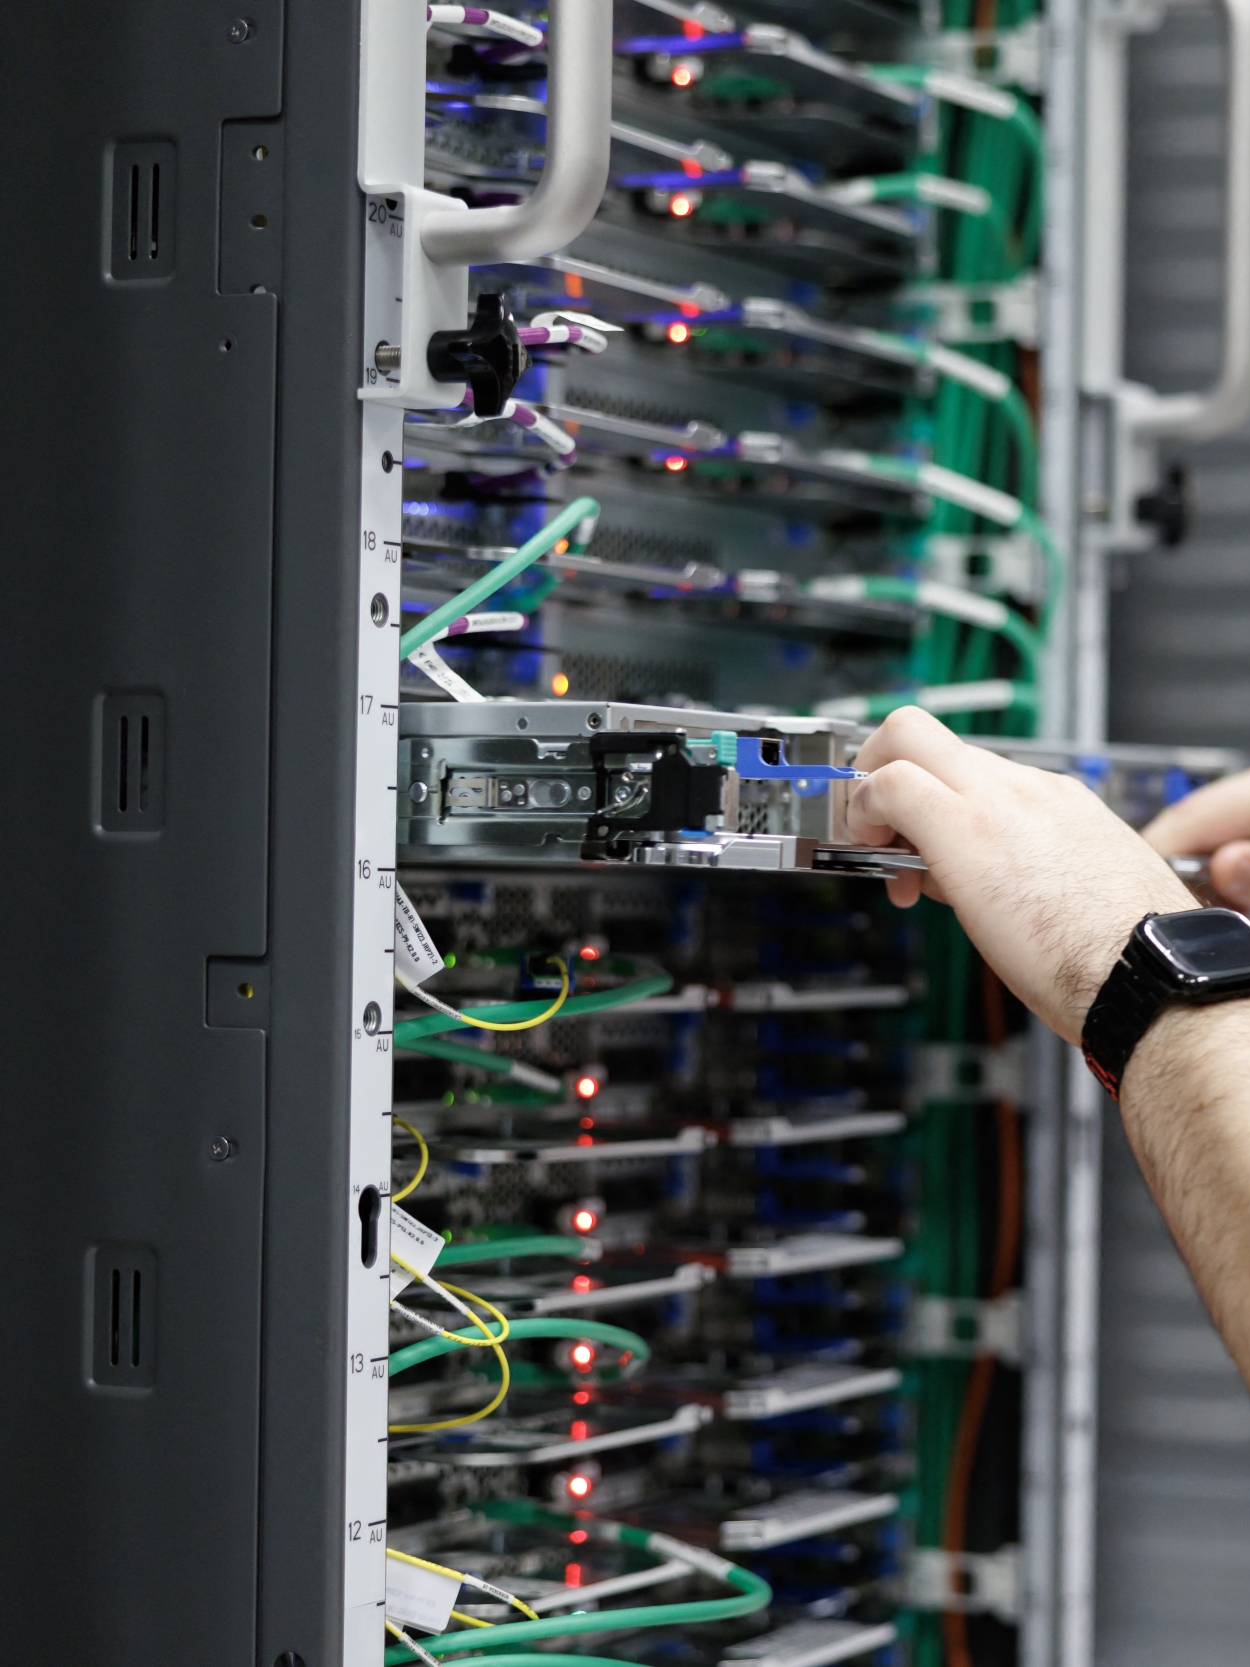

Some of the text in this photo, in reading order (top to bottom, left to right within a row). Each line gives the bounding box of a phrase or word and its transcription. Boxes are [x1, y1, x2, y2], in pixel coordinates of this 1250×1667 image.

[368, 202, 387, 224] 20
[390, 223, 403, 238] AU
[366, 367, 378, 386] 19
[363, 530, 376, 551] 18
[385, 549, 398, 563] AU
[360, 694, 374, 715] 17
[381, 713, 395, 727] AU
[358, 859, 371, 880] 16
[379, 876, 392, 890] AU
[354, 1028, 362, 1040] 15
[376, 1038, 389, 1052] AU
[353, 1184, 361, 1195] 14
[379, 1181, 389, 1191] AU
[351, 1353, 364, 1374] 13
[371, 1365, 384, 1380] AU
[348, 1519, 361, 1542] 12
[369, 1529, 382, 1544] AU
